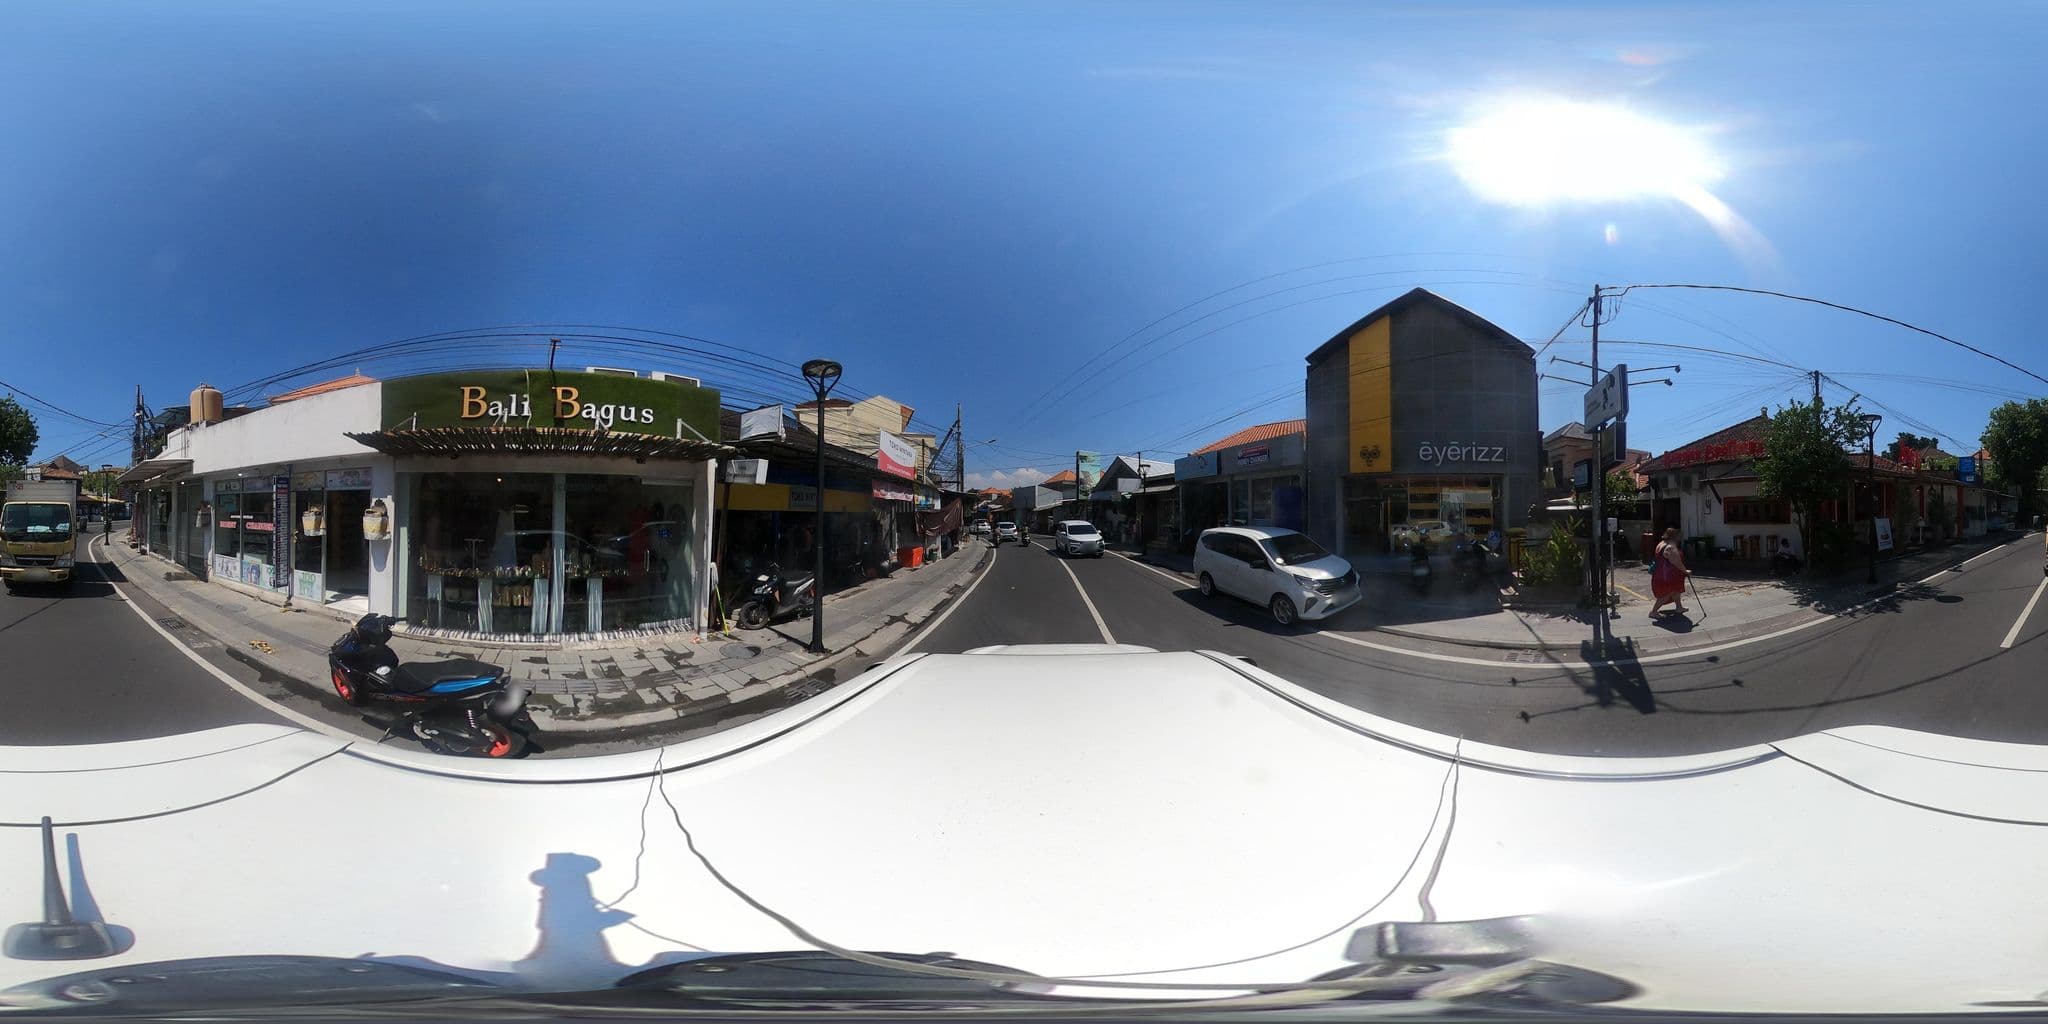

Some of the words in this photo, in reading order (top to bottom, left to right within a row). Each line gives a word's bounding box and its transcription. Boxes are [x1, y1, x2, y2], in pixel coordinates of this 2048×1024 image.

[460, 386, 531, 418] Bali
[552, 386, 654, 429] Bagus
[1419, 441, 1504, 466] ēyērizz
